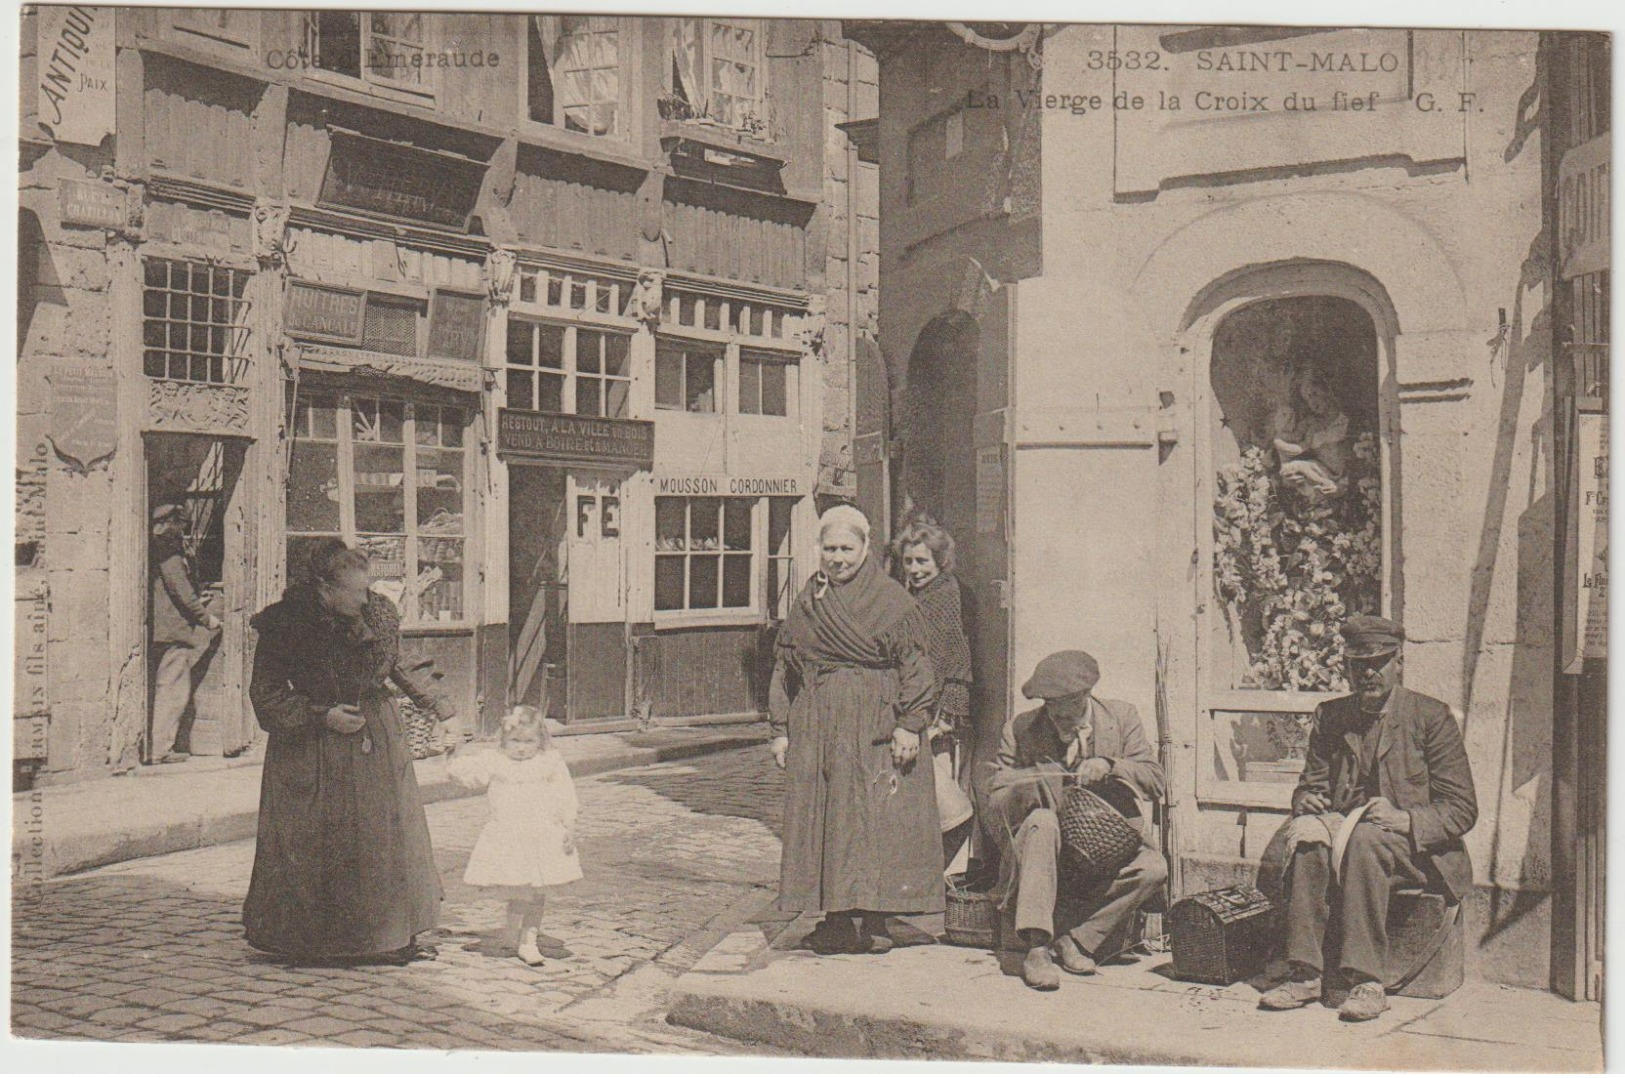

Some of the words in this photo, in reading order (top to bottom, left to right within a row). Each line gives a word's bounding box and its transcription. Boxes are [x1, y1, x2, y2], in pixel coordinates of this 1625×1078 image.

[41, 6, 98, 126] ANTIQUI
[78, 73, 108, 93] PAIX
[579, 422, 610, 437] VILLE
[659, 478, 719, 494] MOUSSON
[730, 478, 798, 494] CORDONNIER
